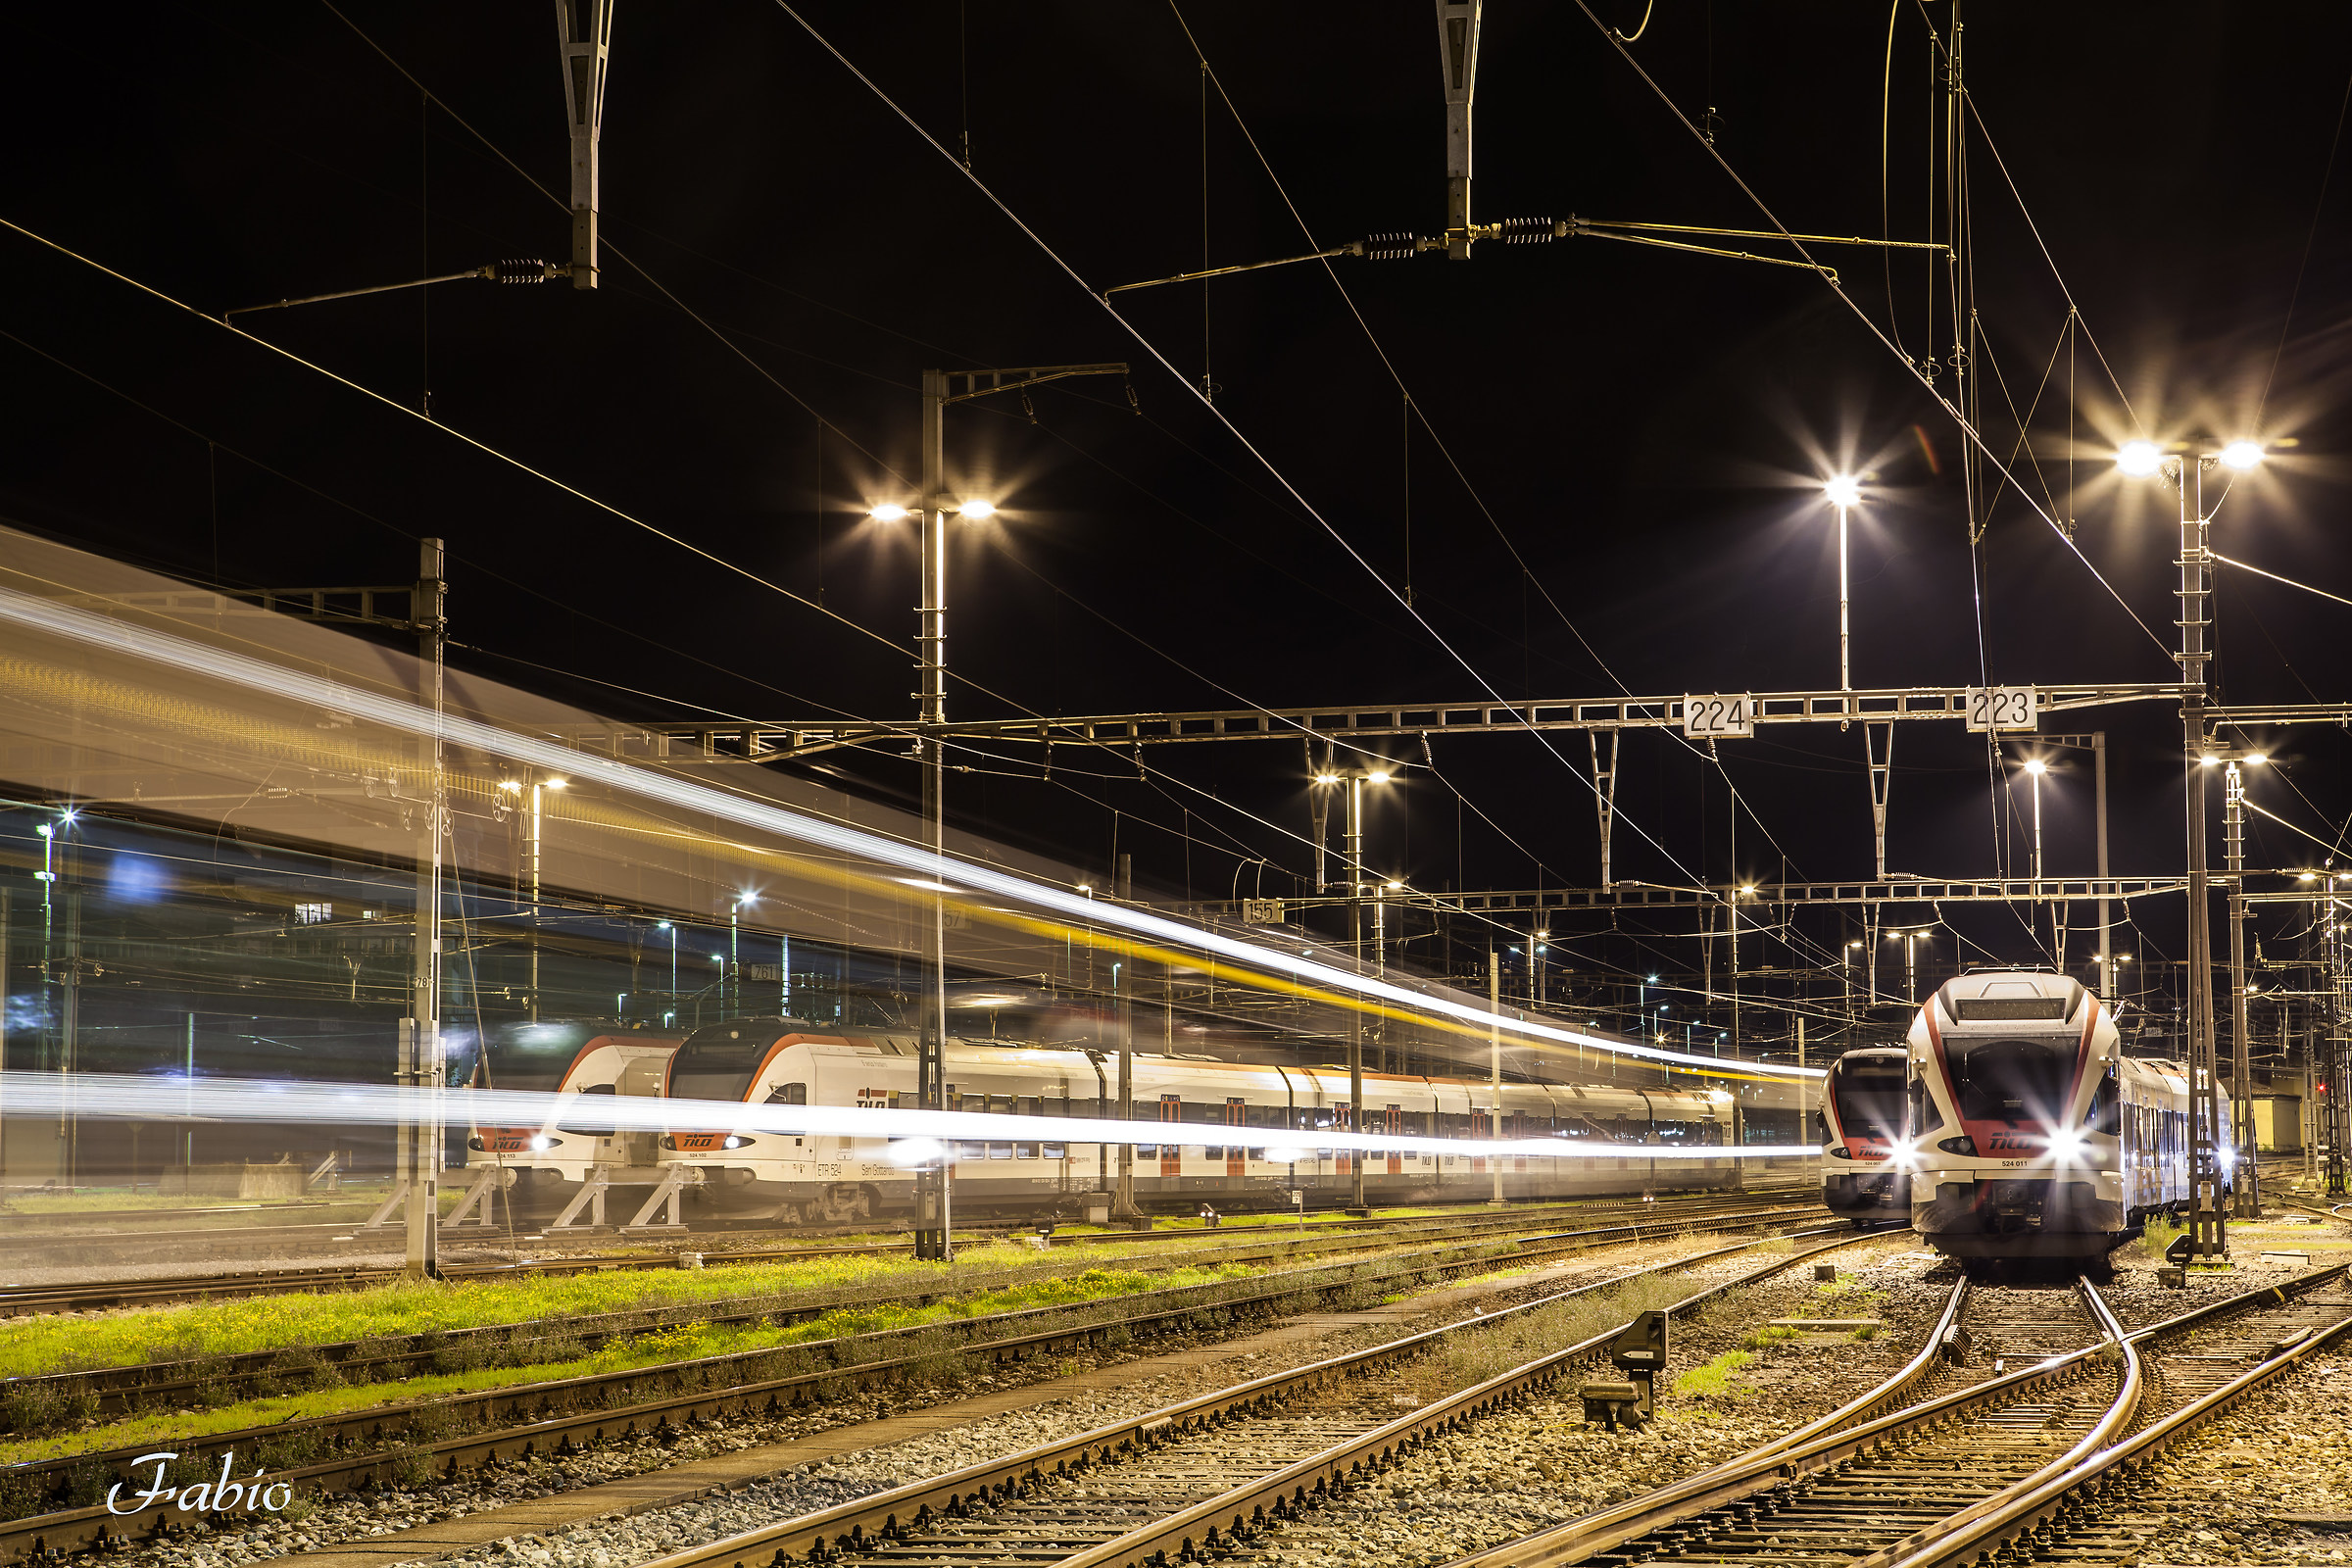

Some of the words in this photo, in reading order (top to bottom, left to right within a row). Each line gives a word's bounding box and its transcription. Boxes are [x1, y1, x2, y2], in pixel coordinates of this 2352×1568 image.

[1690, 700, 1745, 731] 224
[1973, 692, 2028, 724] 223
[1248, 903, 1273, 920] 155
[755, 965, 774, 979] 761
[416, 977, 427, 987] 78
[683, 1135, 713, 1147] TILO
[1989, 1132, 2035, 1150] TILO
[817, 1164, 830, 1176] ETR
[830, 1164, 841, 1176] 524
[861, 1164, 872, 1176] San
